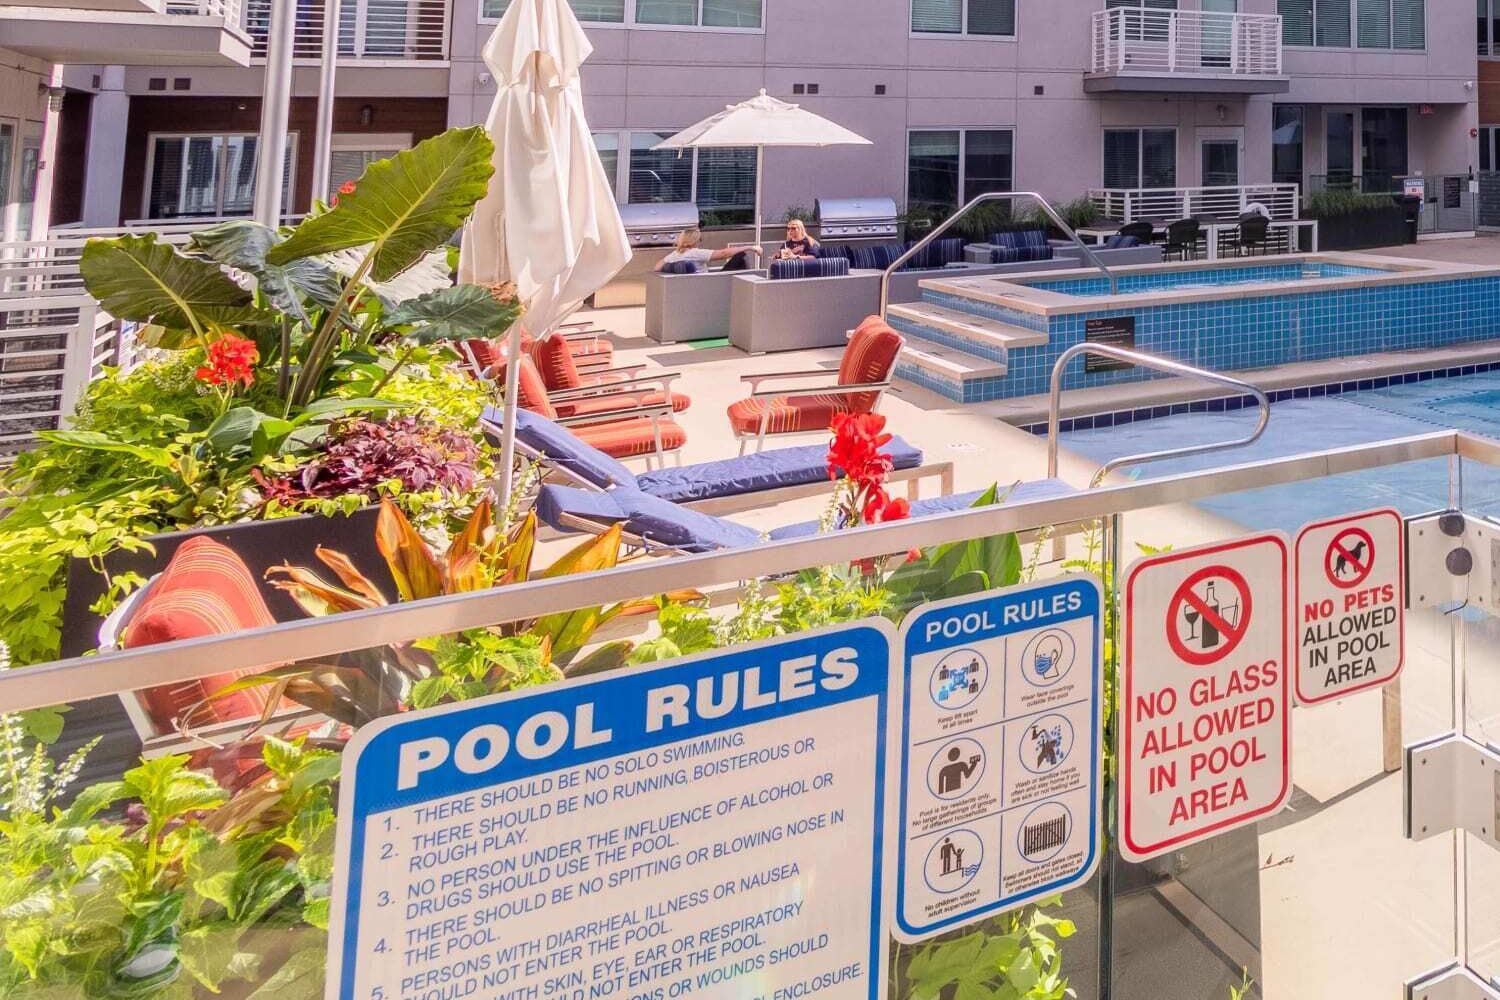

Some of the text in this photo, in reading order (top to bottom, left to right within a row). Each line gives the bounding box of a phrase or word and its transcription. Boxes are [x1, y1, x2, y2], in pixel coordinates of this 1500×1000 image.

[925, 591, 1082, 643] POOL RULES
[1303, 606, 1397, 646] ALLOWED
[1304, 584, 1394, 623] NO PETS
[1309, 638, 1390, 668] IN POOL
[1324, 657, 1377, 687] AREA
[397, 646, 860, 791] POOL RULES
[1136, 660, 1278, 723] NO GLASS
[1140, 697, 1275, 759] ALLOWED
[384, 731, 744, 832] 1. THERE SHOULD BE NO SOLO SWIMMING.
[1148, 737, 1266, 794] IN POOL
[380, 737, 815, 860] 2. THERE SHOULD BE NO RUNNING, BOISTEROUS OR
[1169, 777, 1248, 826] AREA
[377, 772, 834, 907] 3. NO PERSON UNDER THE INFLUENCE OF ALCOHOL OR
[409, 827, 528, 872] ROUGH PLAY.
[374, 808, 844, 954] 4. THERE SHOULD BE NO SPITTING OR BLOWING NOSE IN
[406, 832, 679, 920] DRUGS SHOULD USE THE POOL.
[400, 954, 490, 994] PERSONS
[496, 938, 540, 965] WITH
[546, 910, 640, 950] DIARRHEAL
[645, 890, 709, 921] ILLNESS
[714, 880, 736, 900] OR
[740, 862, 799, 892] NAUSEA
[403, 920, 672, 1000] OULD NOT ENTER THE POOL.
[404, 927, 500, 966] THE POOL.
[494, 983, 538, 1000] ITH
[543, 968, 587, 994] SKIN,
[592, 955, 629, 980] EYE,
[634, 943, 667, 966] EAR
[672, 936, 694, 954] OR
[700, 900, 803, 945] RESPIRATORY
[589, 974, 624, 998] NOT
[628, 957, 682, 988] ENTER
[686, 945, 717, 968] THE
[720, 932, 766, 957] POOL.
[668, 933, 828, 998] OR WOUNDS SHOULD
